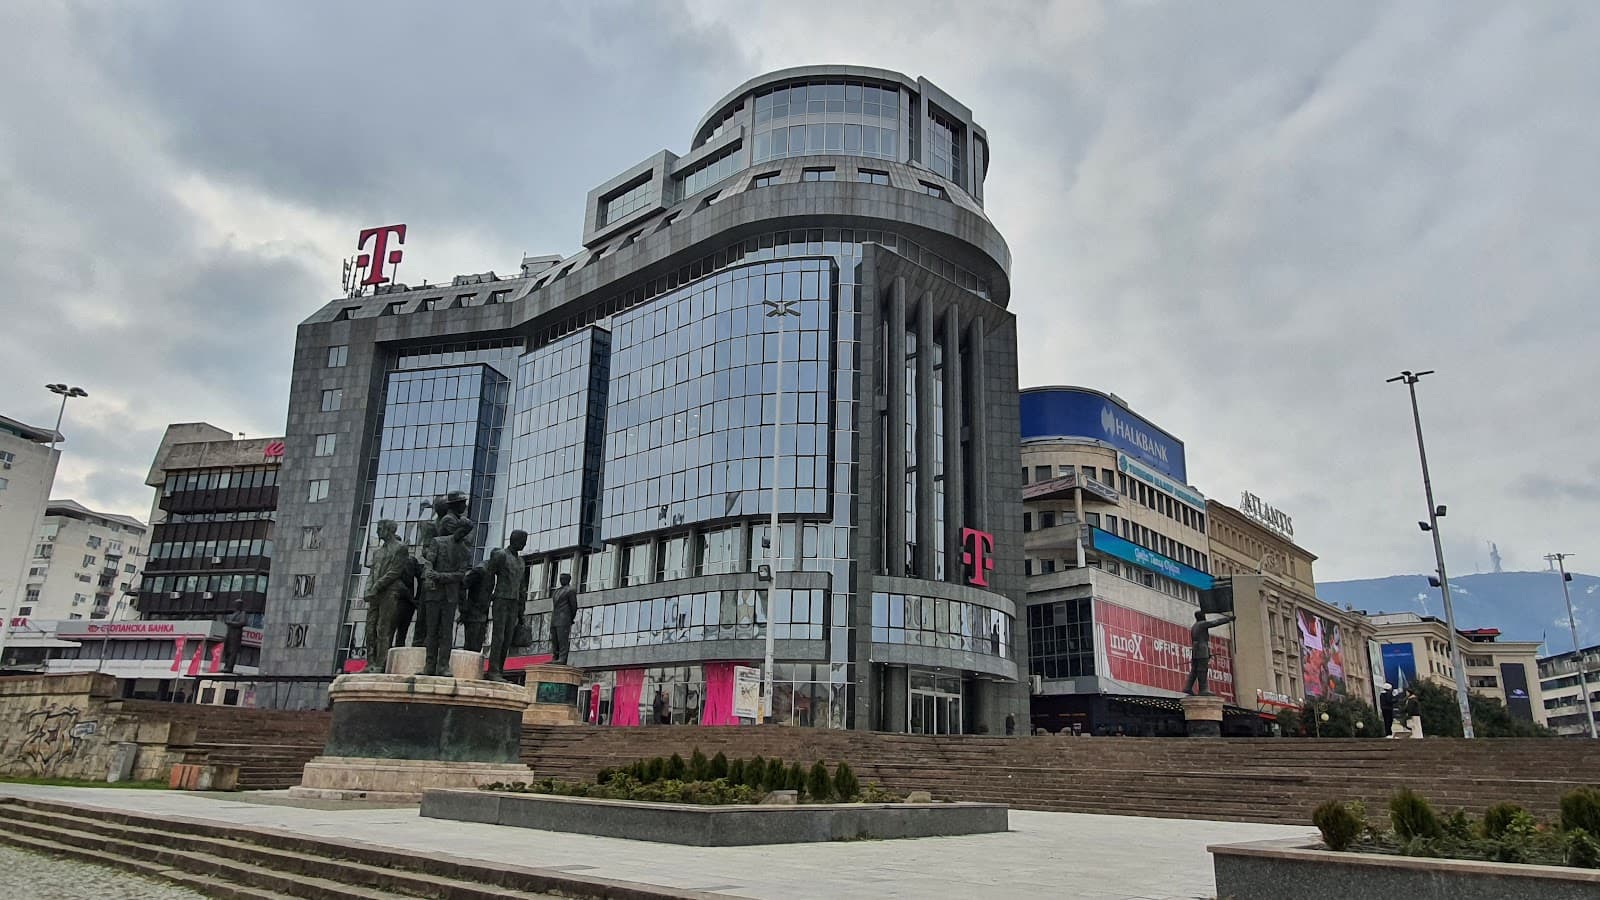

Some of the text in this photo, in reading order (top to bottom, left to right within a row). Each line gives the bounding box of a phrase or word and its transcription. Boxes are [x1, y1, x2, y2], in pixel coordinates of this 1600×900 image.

[357, 224, 406, 285] T
[1115, 418, 1168, 463] HALKBANK
[1240, 490, 1294, 536] ATLANTIS
[962, 527, 995, 587] T
[148, 624, 174, 633] БАНКА
[1153, 640, 1180, 656] OFFICE
